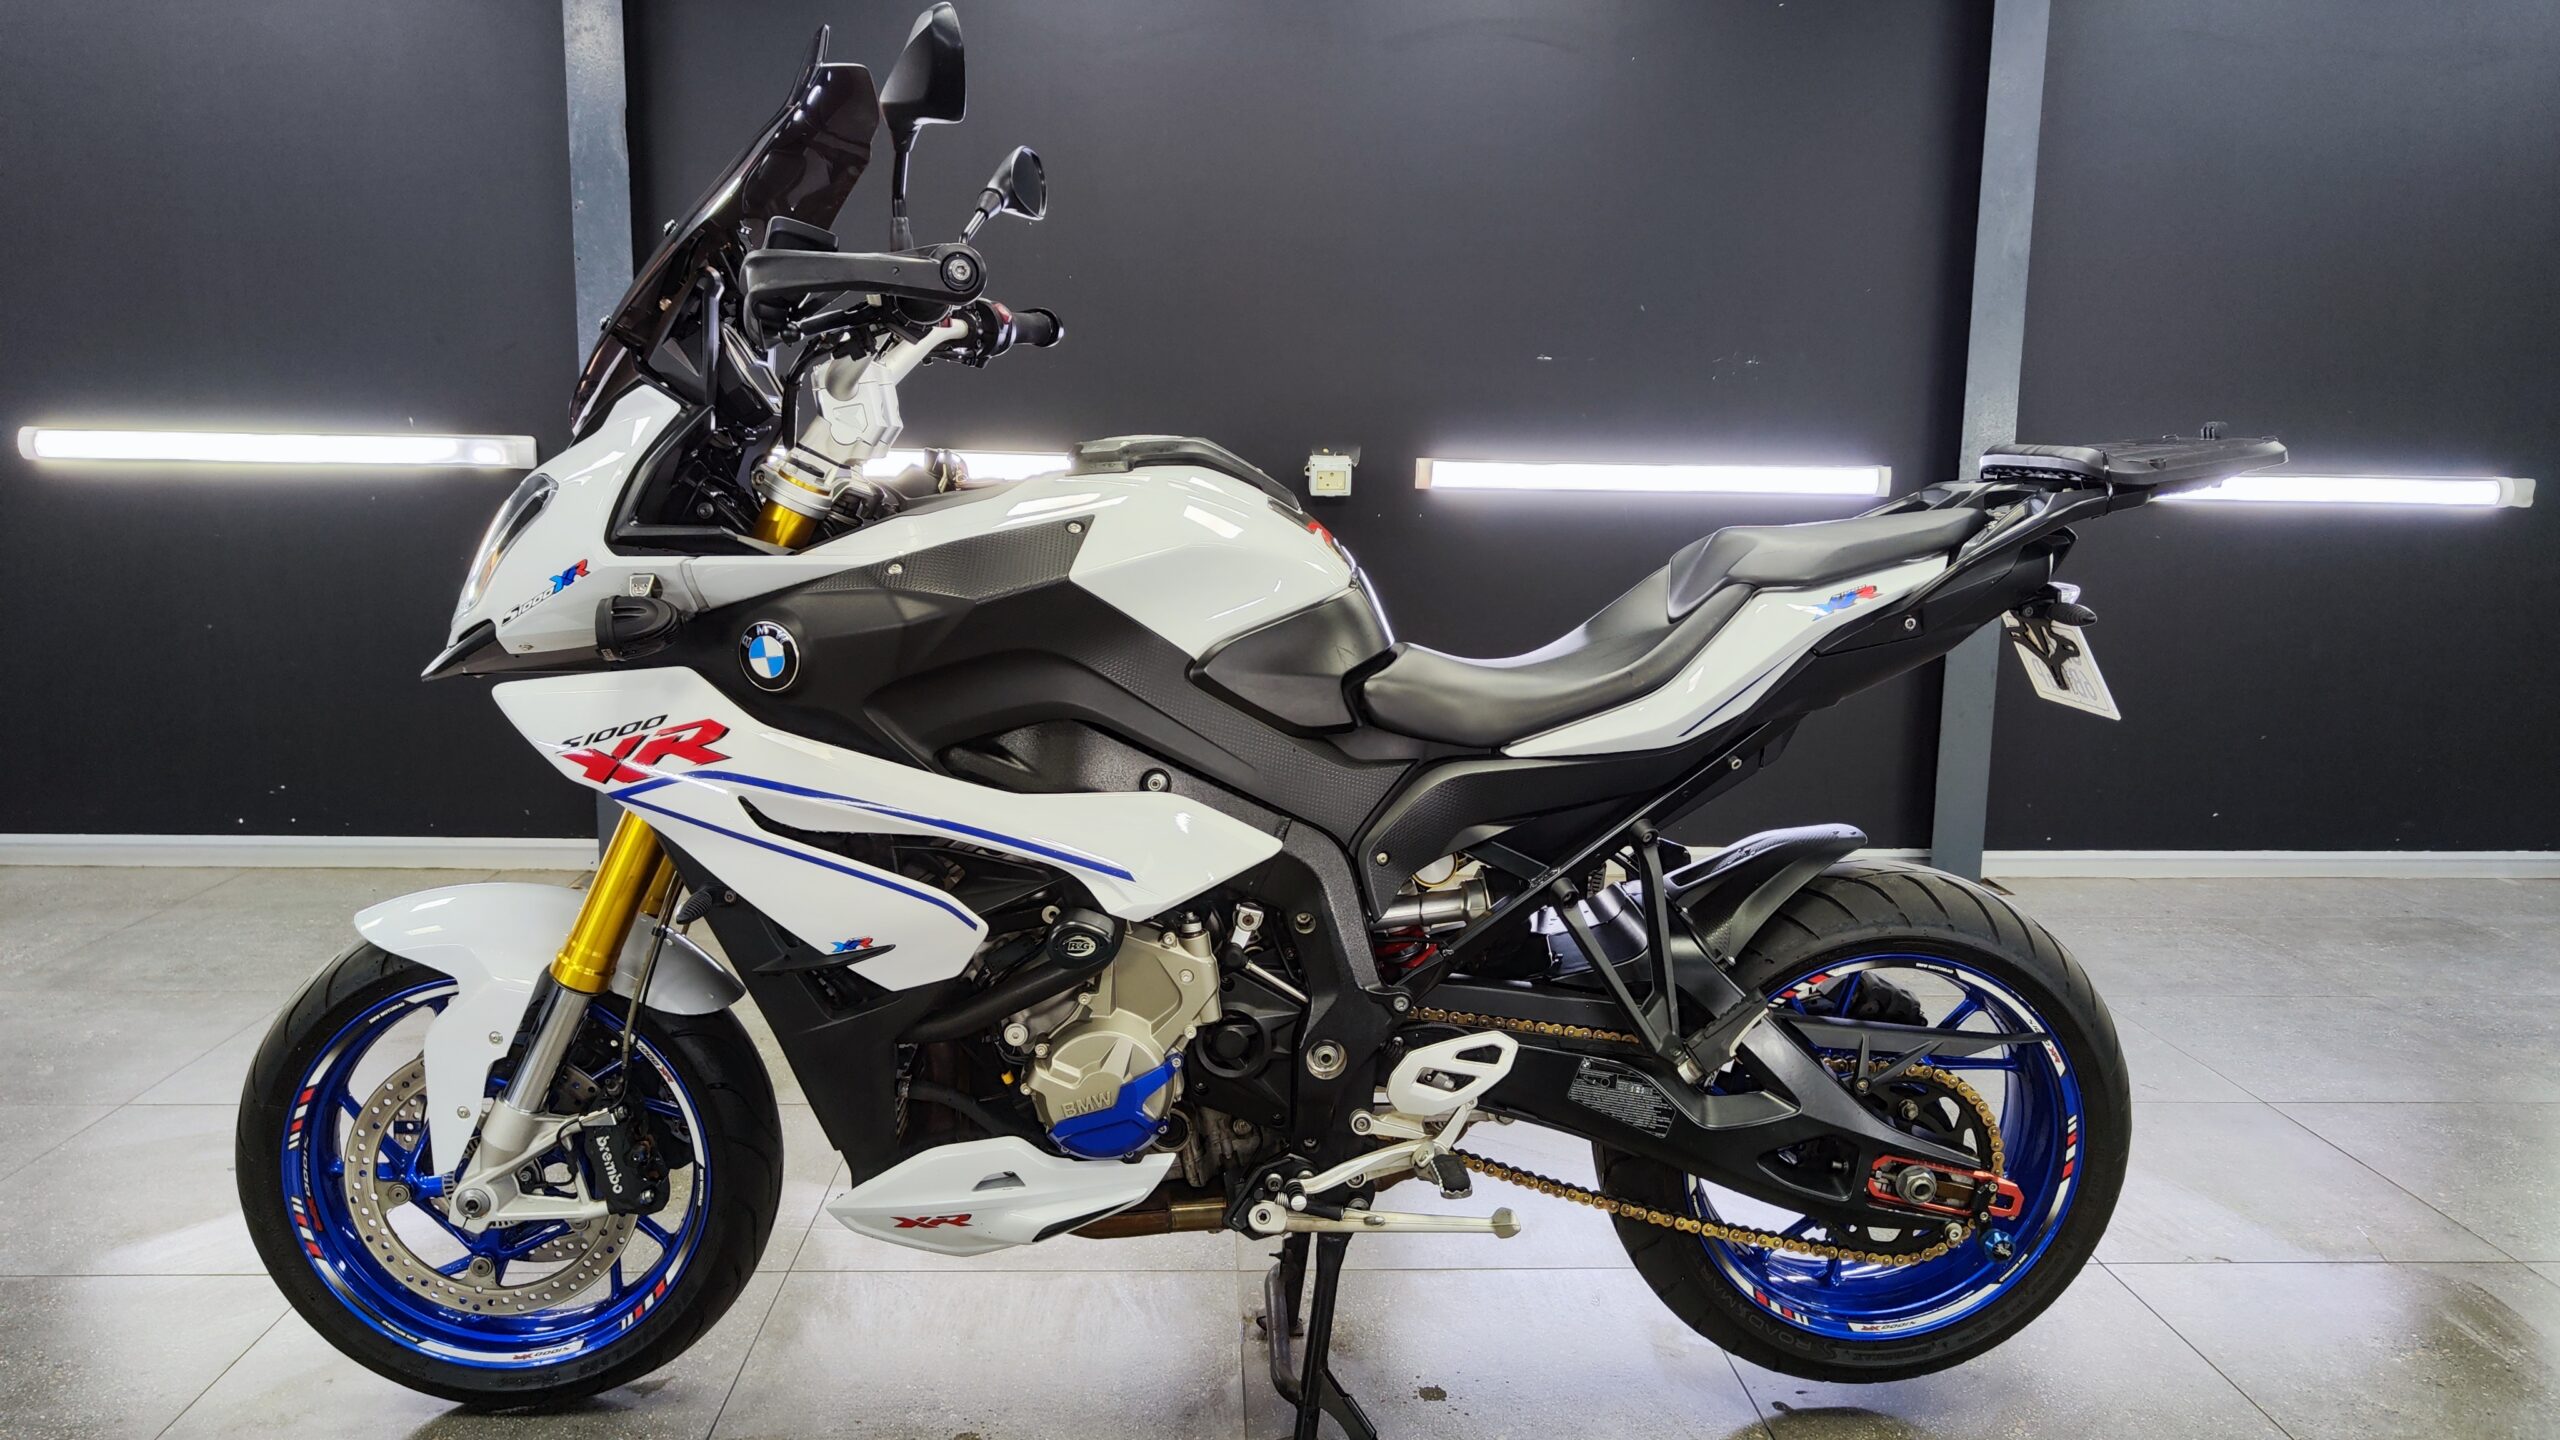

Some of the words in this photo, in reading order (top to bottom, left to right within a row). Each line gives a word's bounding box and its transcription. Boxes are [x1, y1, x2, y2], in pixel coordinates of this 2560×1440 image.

[741, 624, 790, 649] BMW
[556, 713, 669, 755] S1000
[561, 718, 733, 785] XR
[1067, 941, 1091, 951] R&G
[1061, 1090, 1112, 1118] BMW
[596, 1135, 624, 1195] brembo
[890, 1213, 975, 1229] XR
